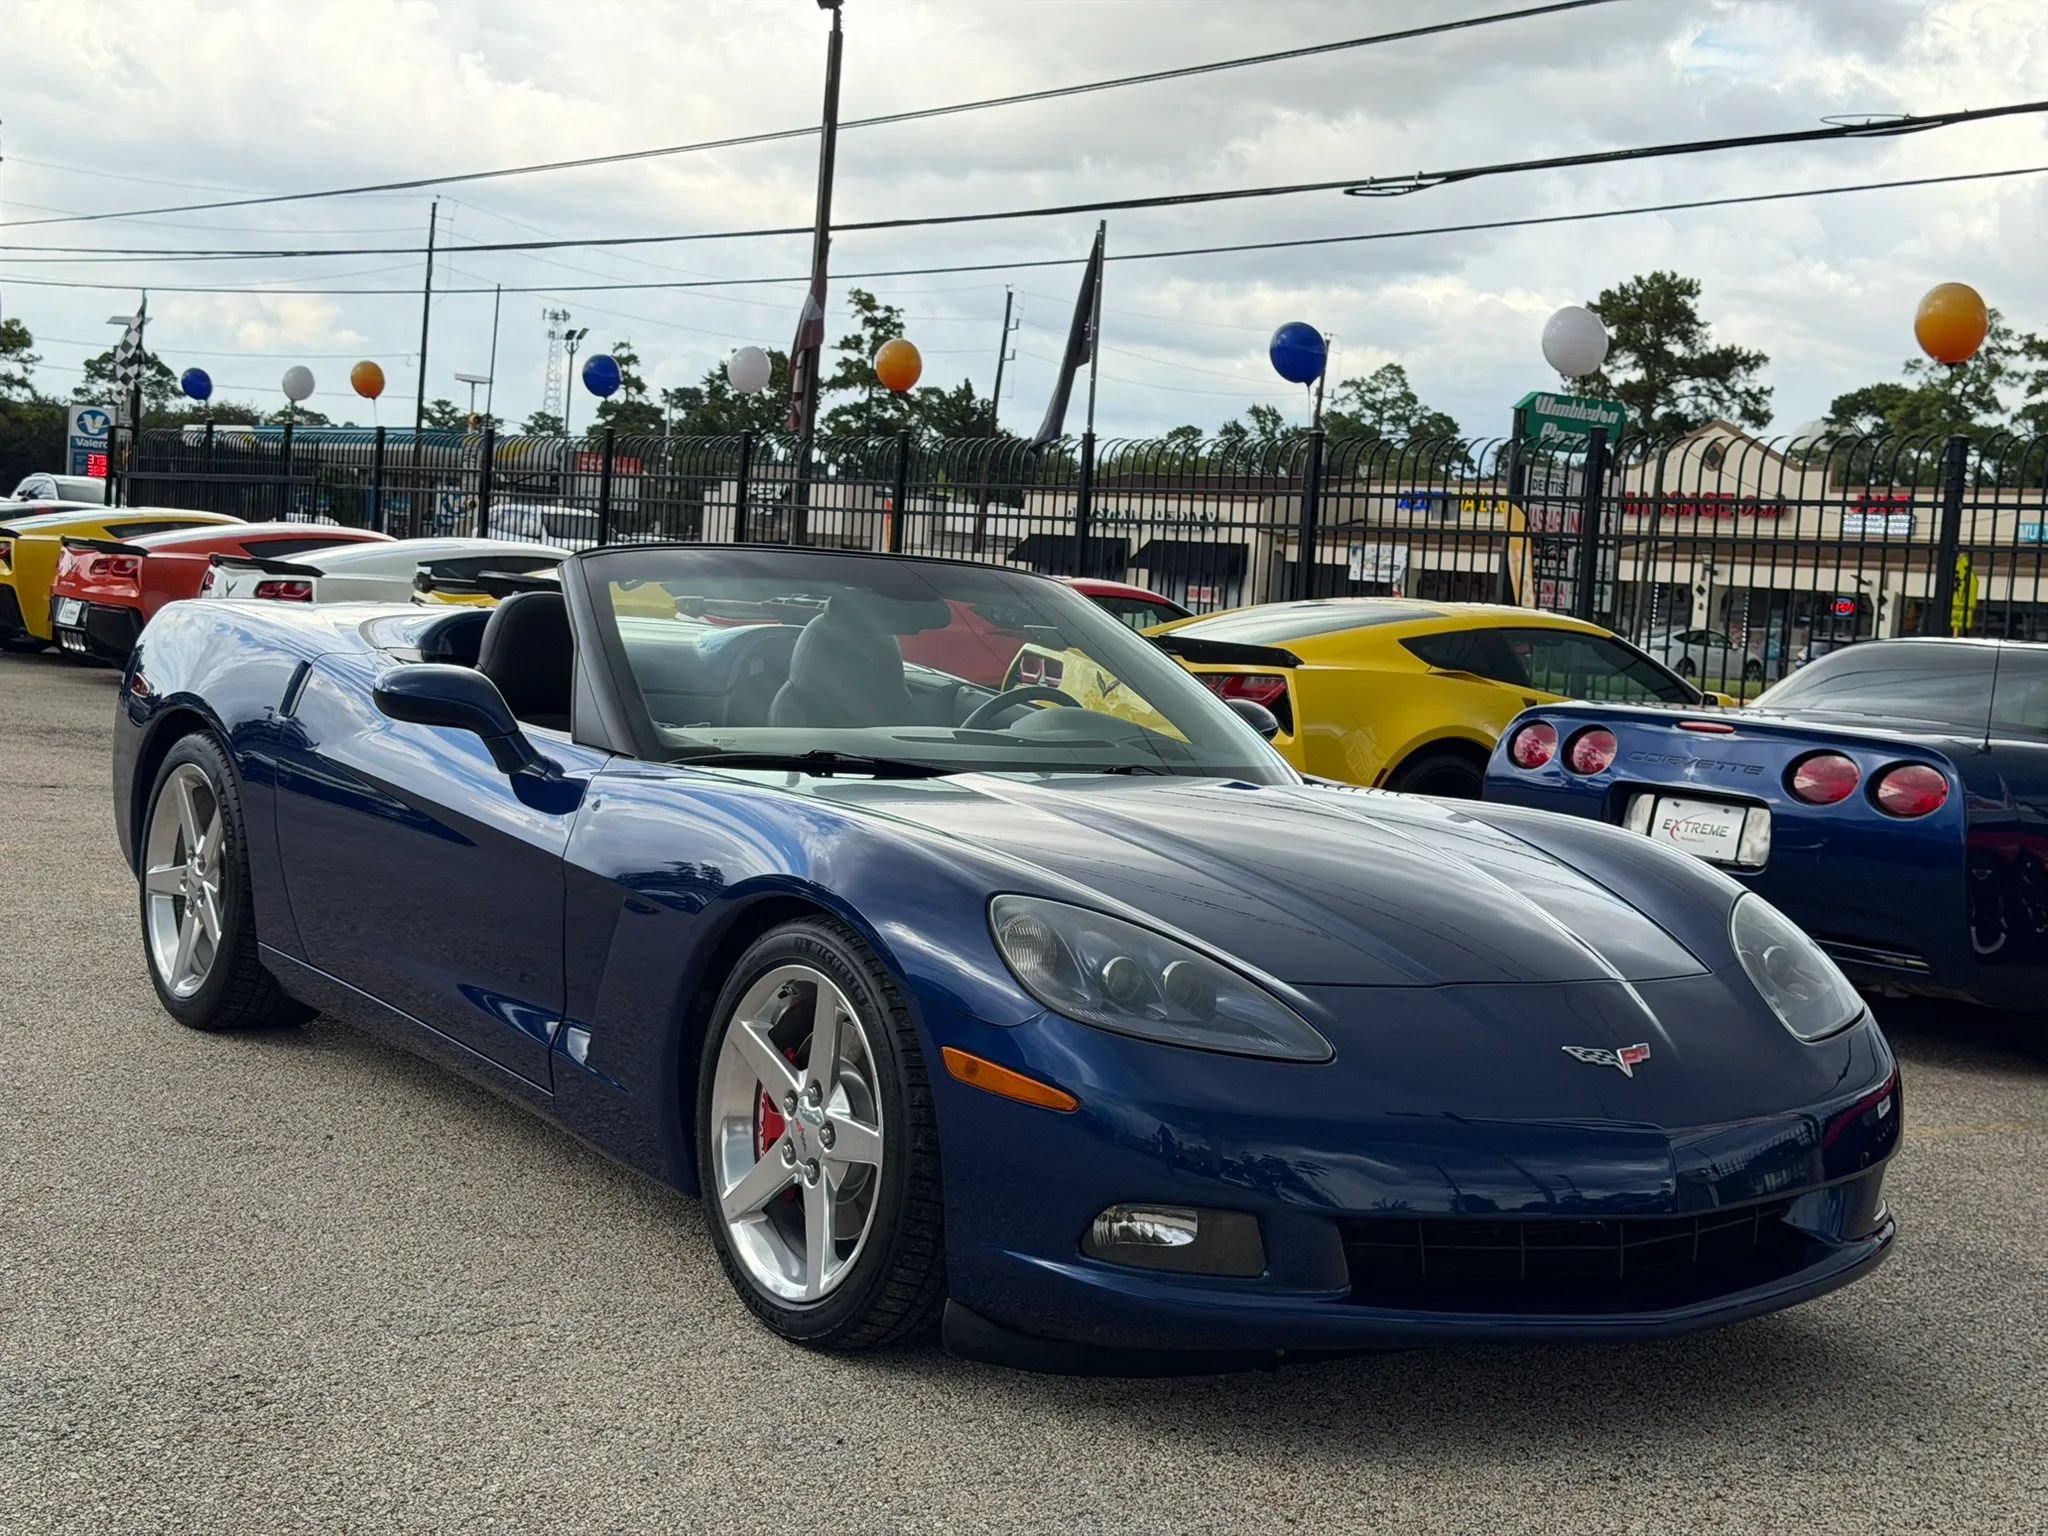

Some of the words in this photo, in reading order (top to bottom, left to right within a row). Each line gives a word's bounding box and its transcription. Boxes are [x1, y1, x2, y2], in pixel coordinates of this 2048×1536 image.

[1534, 395, 1619, 424] Wimbledon
[1532, 479, 1569, 496] DETIS
[1622, 491, 1735, 519] MASAGE
[1627, 751, 1765, 776] CORVETTE
[1662, 818, 1730, 839] EXTREME
